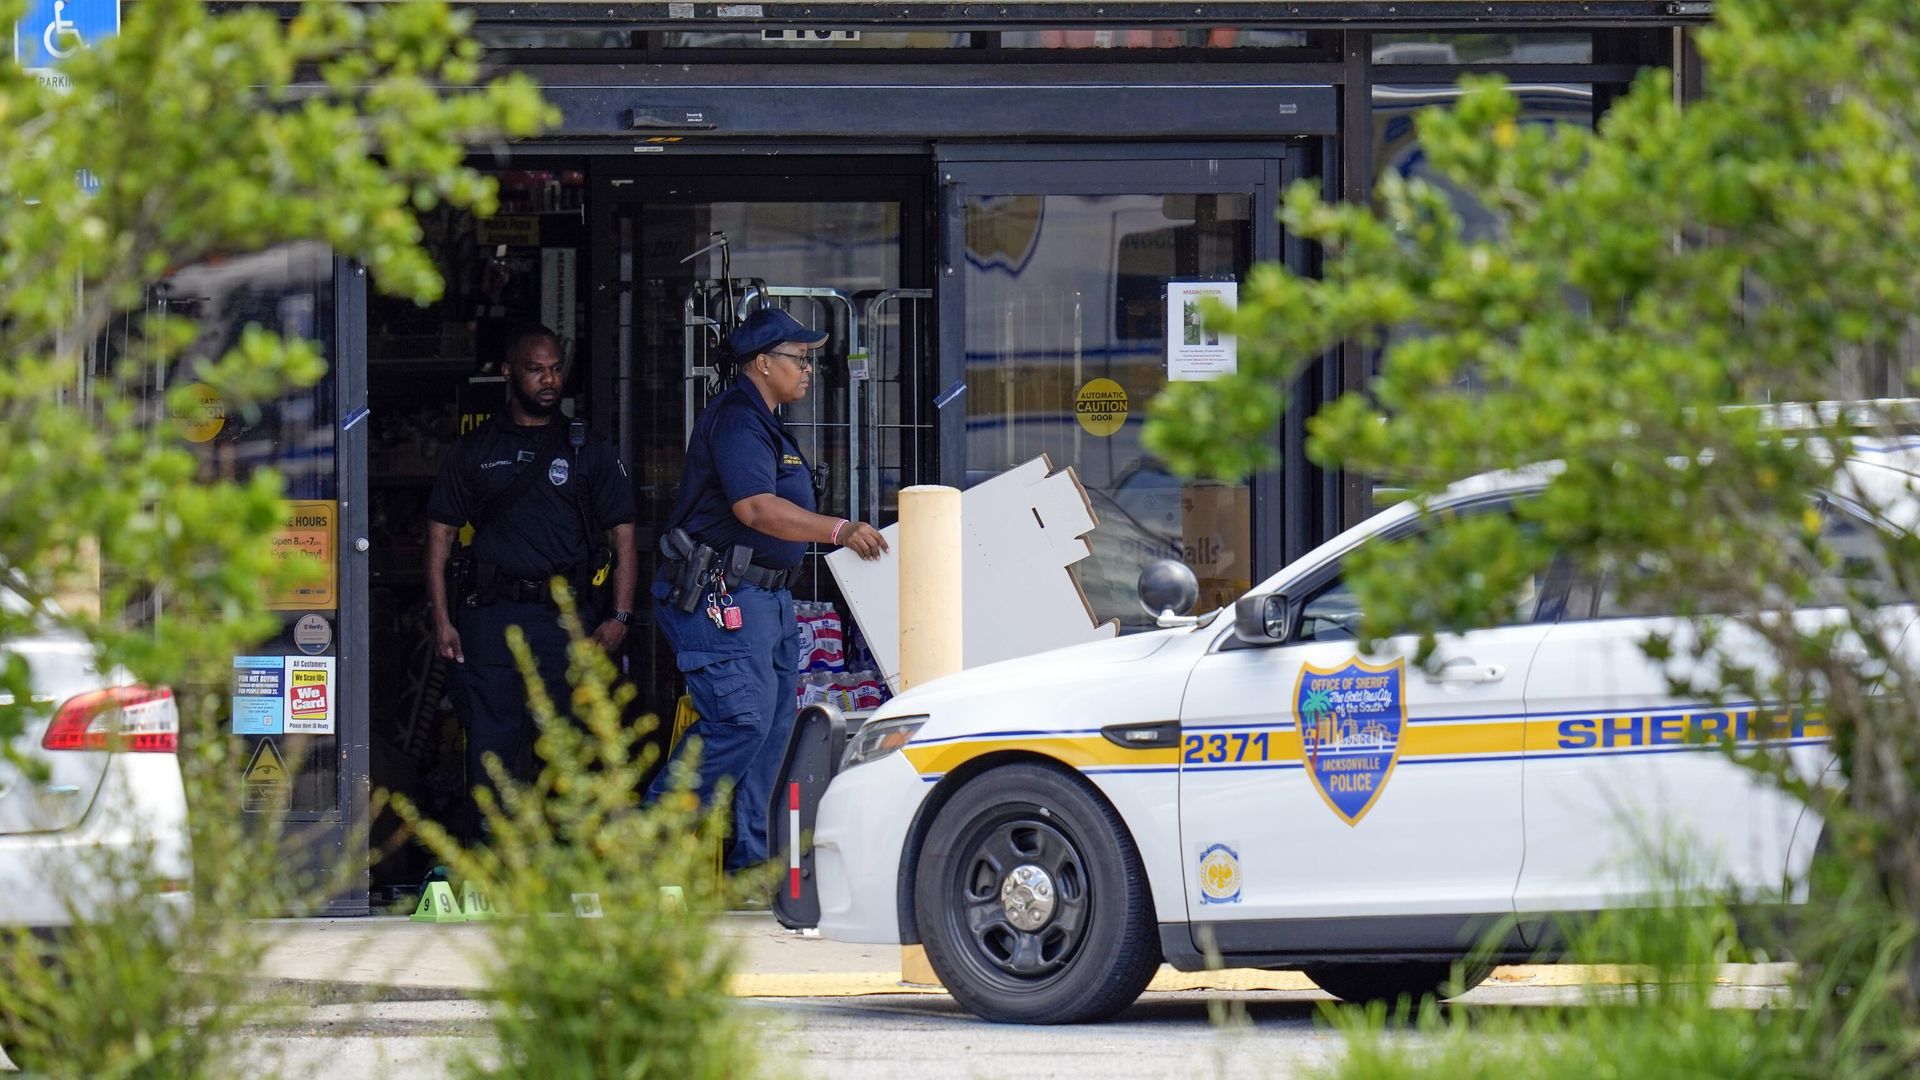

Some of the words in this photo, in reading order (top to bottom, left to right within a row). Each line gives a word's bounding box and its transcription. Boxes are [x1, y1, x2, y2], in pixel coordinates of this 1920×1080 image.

[39, 77, 74, 88] PARKIN
[1080, 391, 1124, 399] AUTOMATIC
[1076, 401, 1128, 412] CAUTION
[295, 516, 327, 527] HOURS
[271, 537, 292, 546] Open
[301, 660, 327, 668] Customers
[1311, 678, 1340, 691] OFFICE
[1342, 678, 1354, 690] OF
[1355, 676, 1390, 689] SHERIFF
[297, 687, 320, 699] We
[1329, 691, 1345, 703] The
[292, 697, 326, 710] Card
[1335, 703, 1346, 717] of
[1346, 702, 1359, 714] the
[1359, 701, 1385, 713] South
[1184, 732, 1269, 764] 2371
[1322, 757, 1380, 772] JACKSONVILLE
[1330, 773, 1372, 792] POLICE
[424, 898, 430, 911] 9
[440, 893, 451, 913] 9
[470, 891, 489, 912] 10
